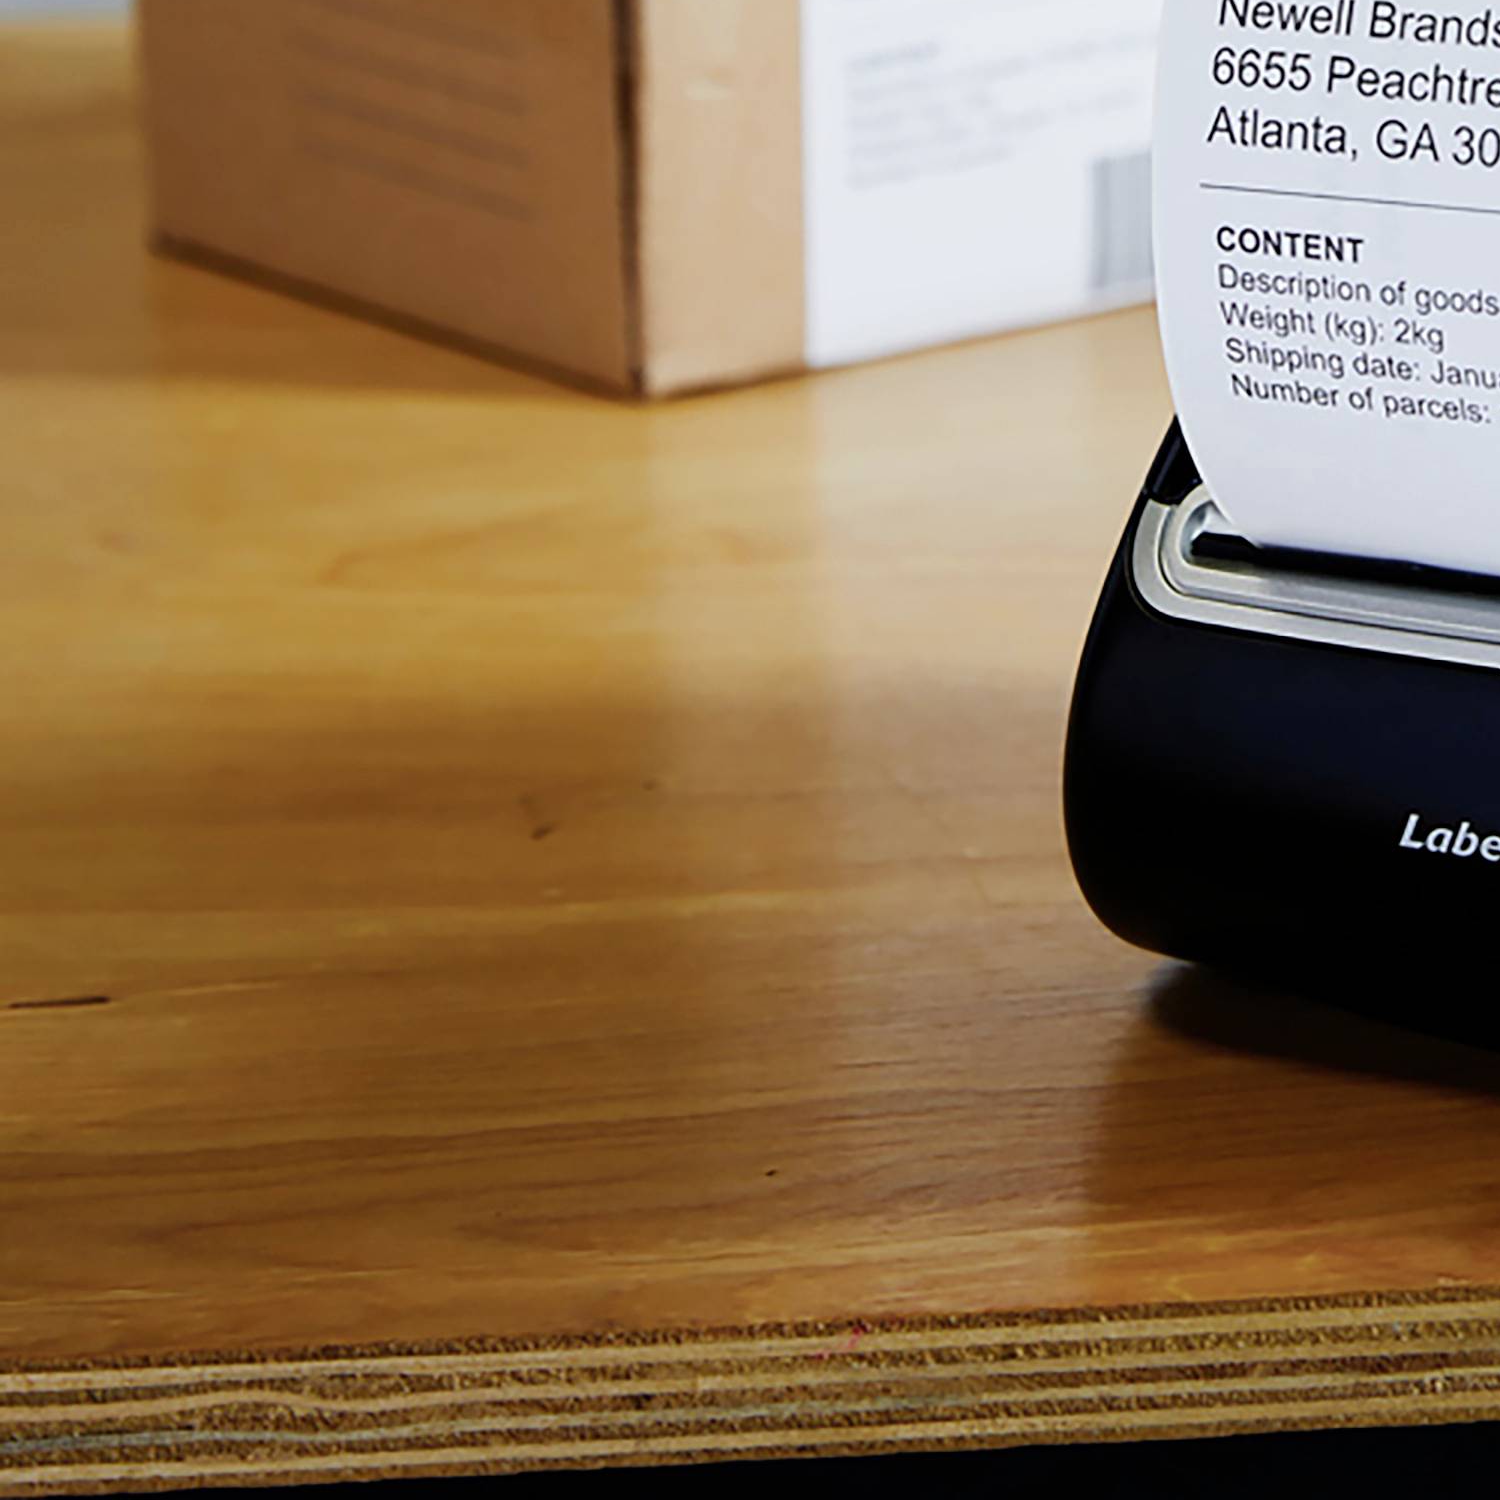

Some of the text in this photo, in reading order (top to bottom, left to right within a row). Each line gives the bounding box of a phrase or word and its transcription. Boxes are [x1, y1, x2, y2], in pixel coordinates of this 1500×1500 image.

[1213, 47, 1311, 91] 6655
[1207, 106, 1357, 161] Atlanta,
[1376, 119, 1440, 162] GA
[1217, 226, 1364, 263] CONTENT
[1218, 264, 1371, 302] Description
[1380, 281, 1406, 306] of
[1220, 301, 1444, 354] Weight (kg): 2kg
[1226, 337, 1344, 379] Shipping
[1353, 353, 1420, 380] date:
[1231, 373, 1338, 406] Number
[1349, 387, 1372, 410] of
[1383, 396, 1490, 423] parcels:
